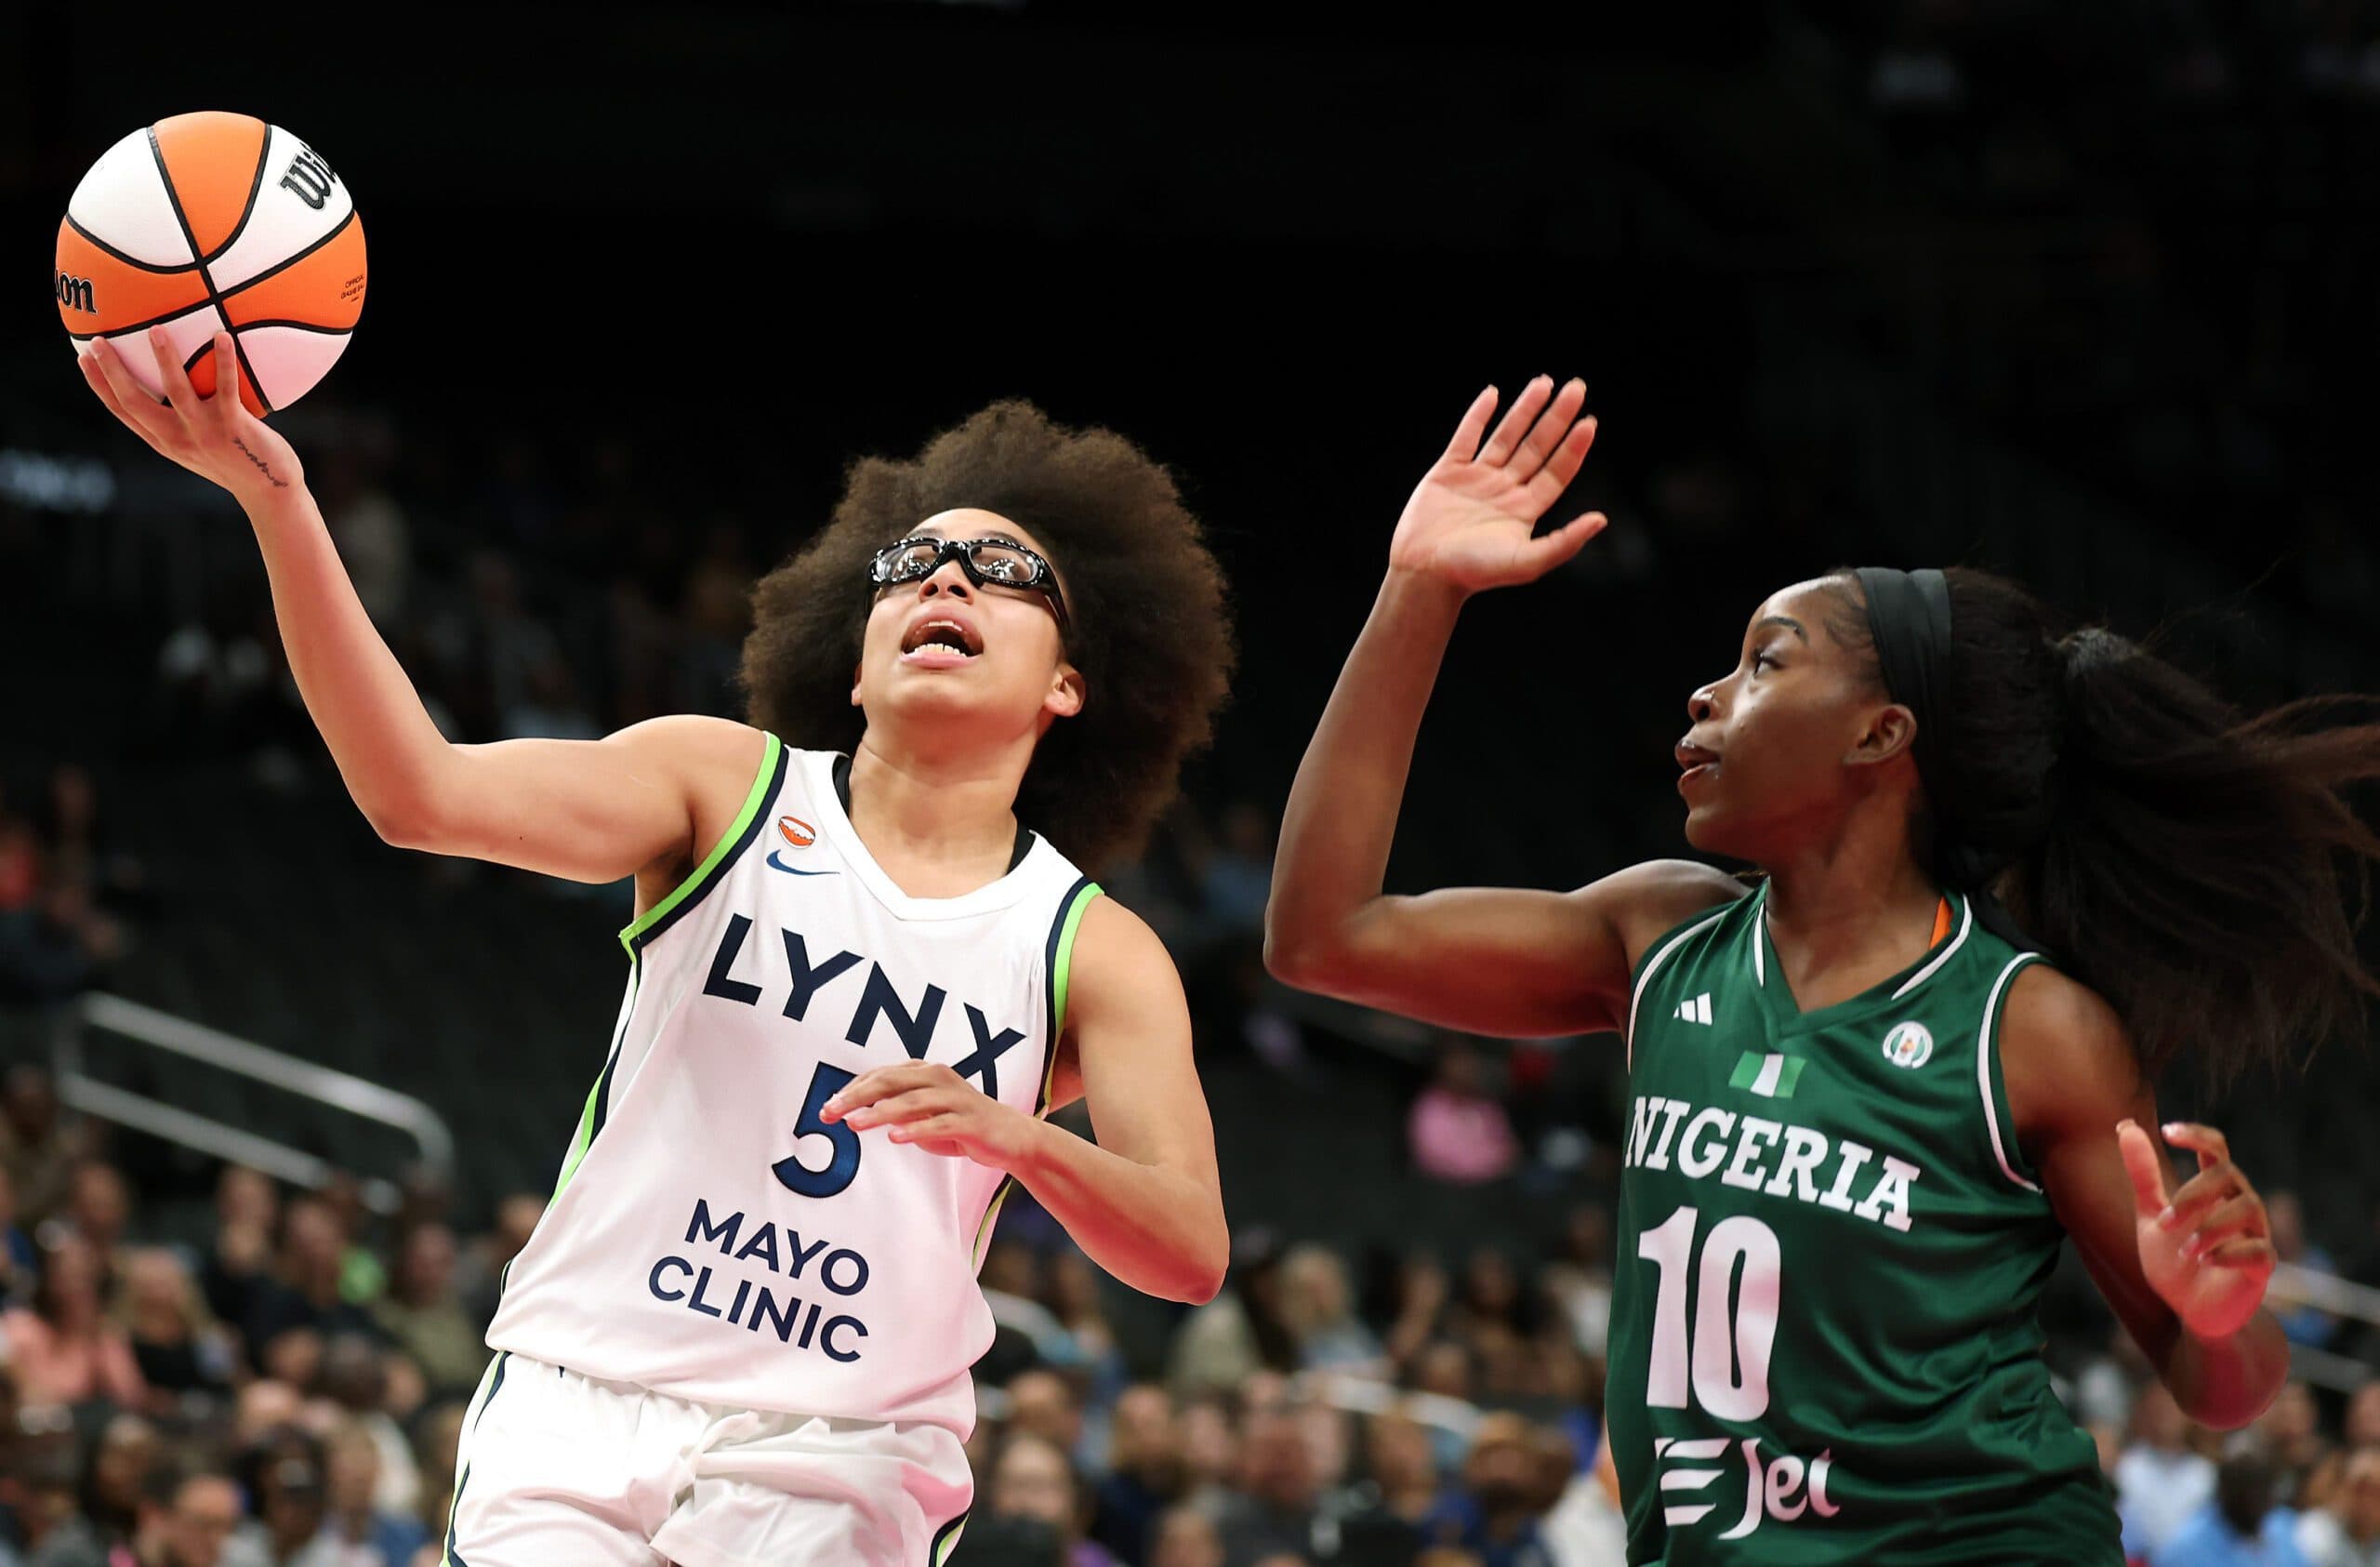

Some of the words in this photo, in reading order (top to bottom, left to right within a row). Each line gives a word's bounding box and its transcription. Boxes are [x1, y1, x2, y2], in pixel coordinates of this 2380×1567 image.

[703, 913, 1026, 1101] LYNX
[772, 1061, 861, 1199] 5
[1625, 1096, 1921, 1232] NIGERIA
[649, 1256, 869, 1362] CLINIC
[685, 1199, 869, 1295] MAYO
[1638, 1206, 1781, 1422] 10
